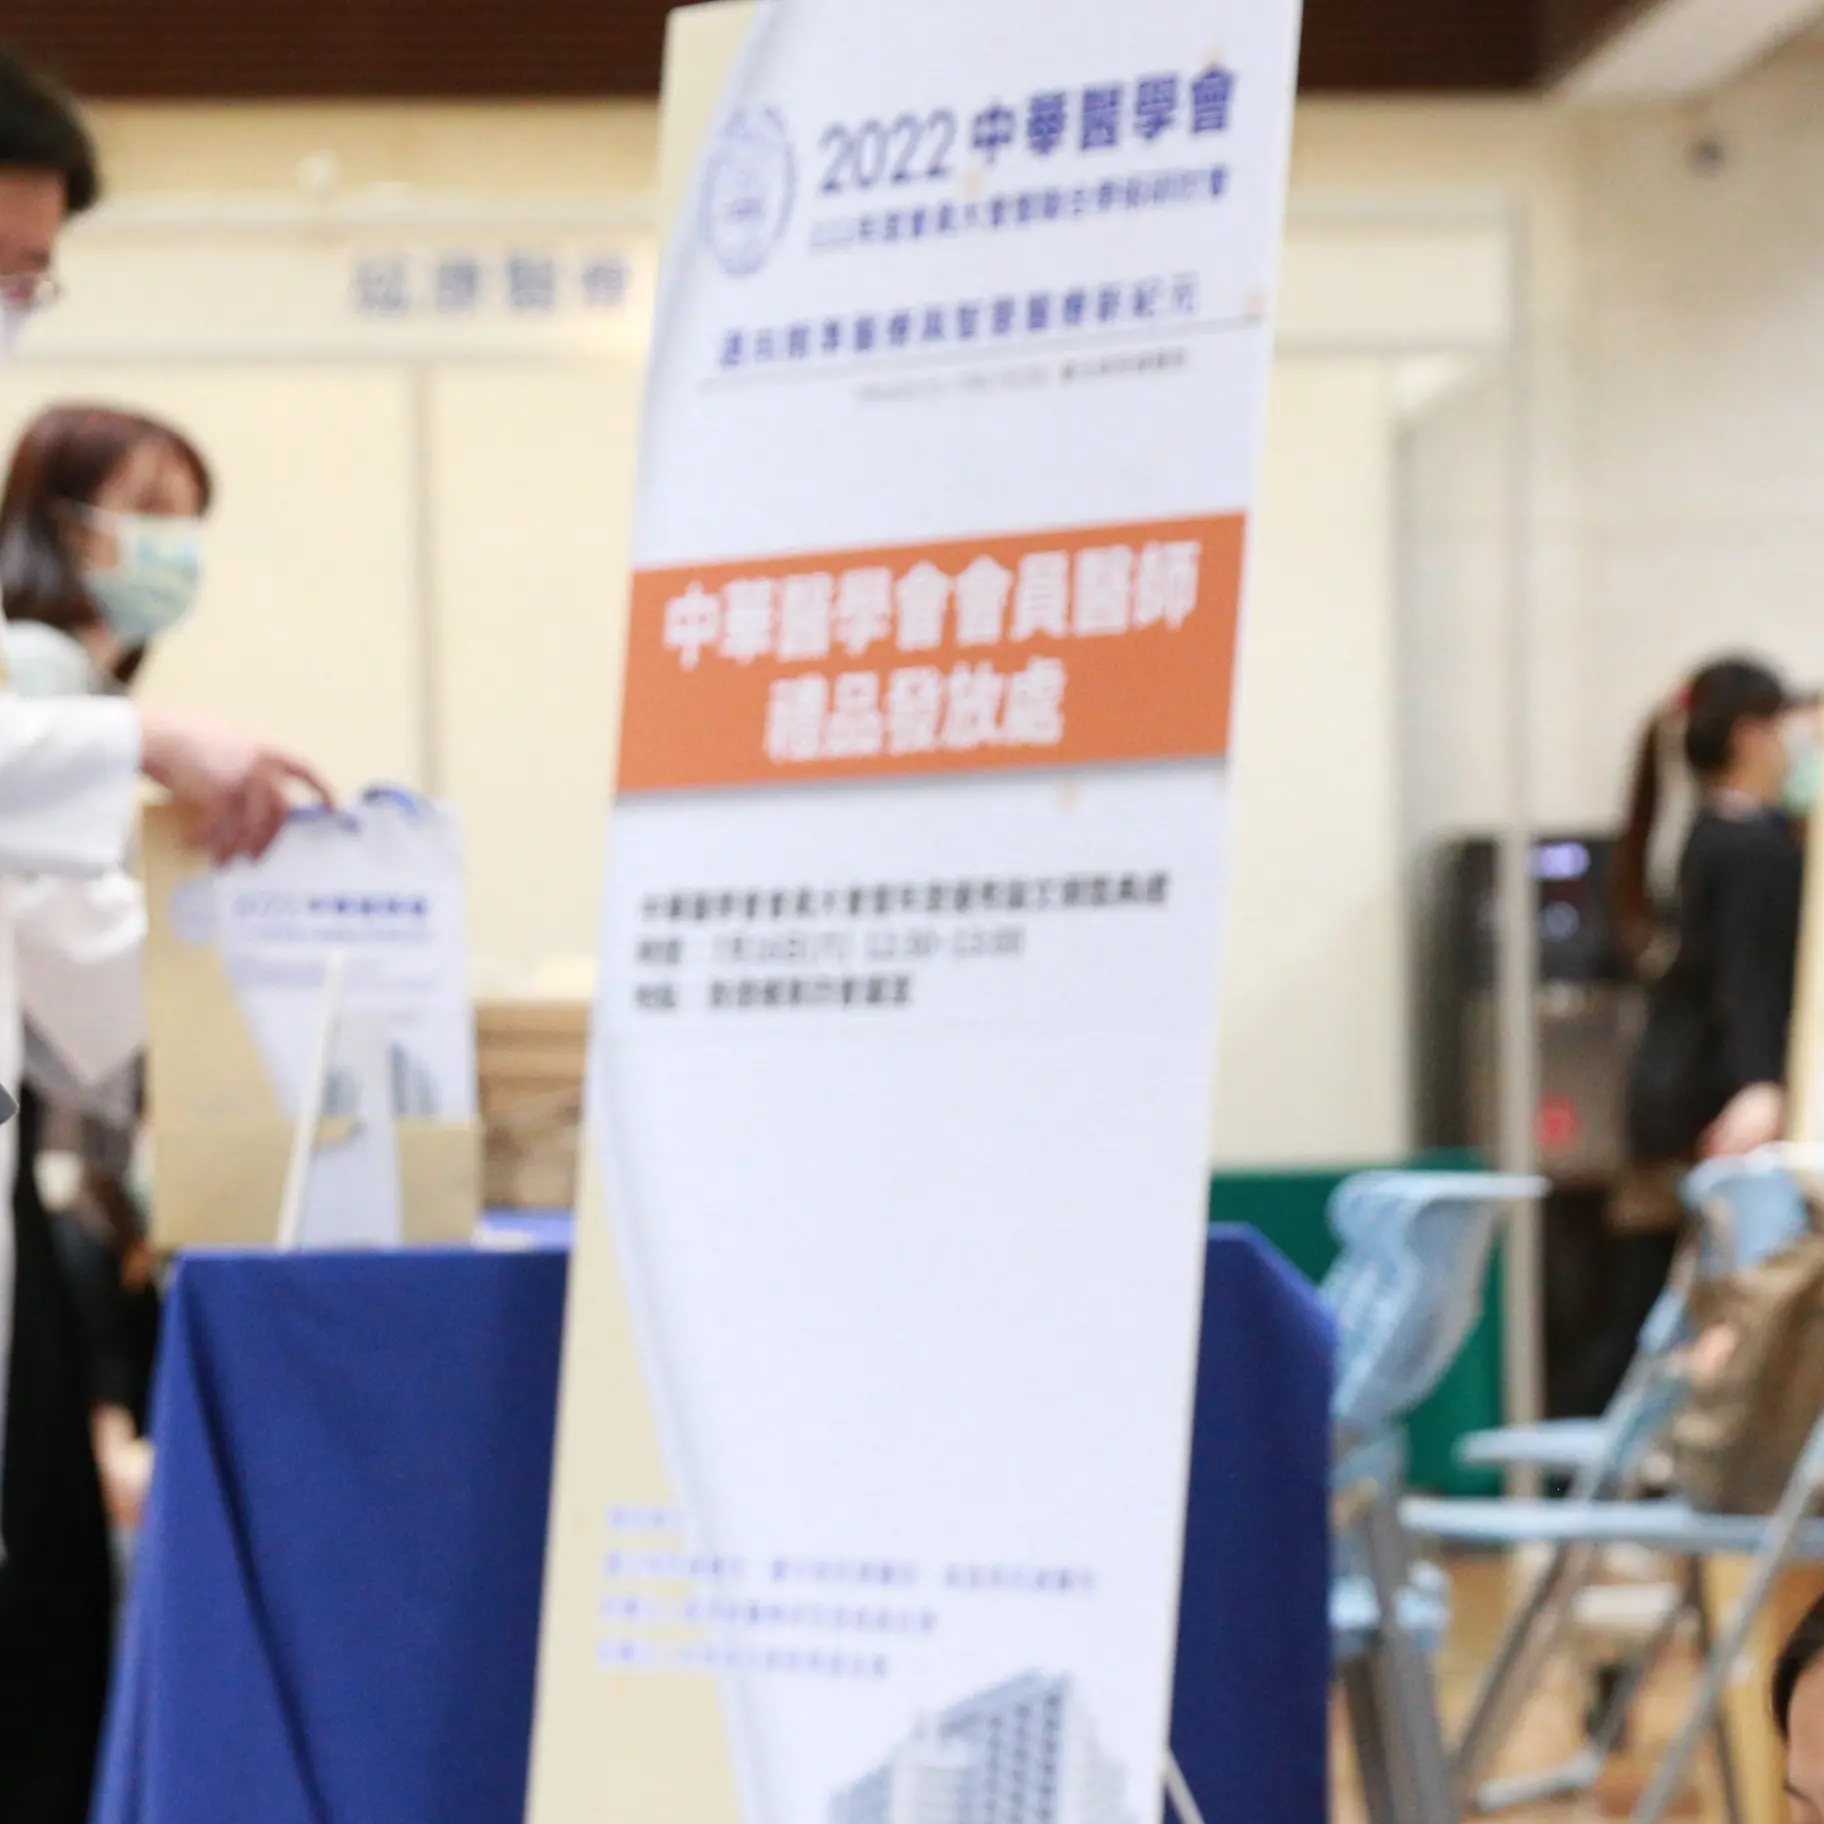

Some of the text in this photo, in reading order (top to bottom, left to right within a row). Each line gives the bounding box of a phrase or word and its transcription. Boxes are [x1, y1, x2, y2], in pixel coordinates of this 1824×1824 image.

[821, 65, 1237, 193] 2022 中華醫學會
[667, 543, 1199, 665] 中華醫學會會員醫師
[768, 660, 1063, 760] 禮品發放處
